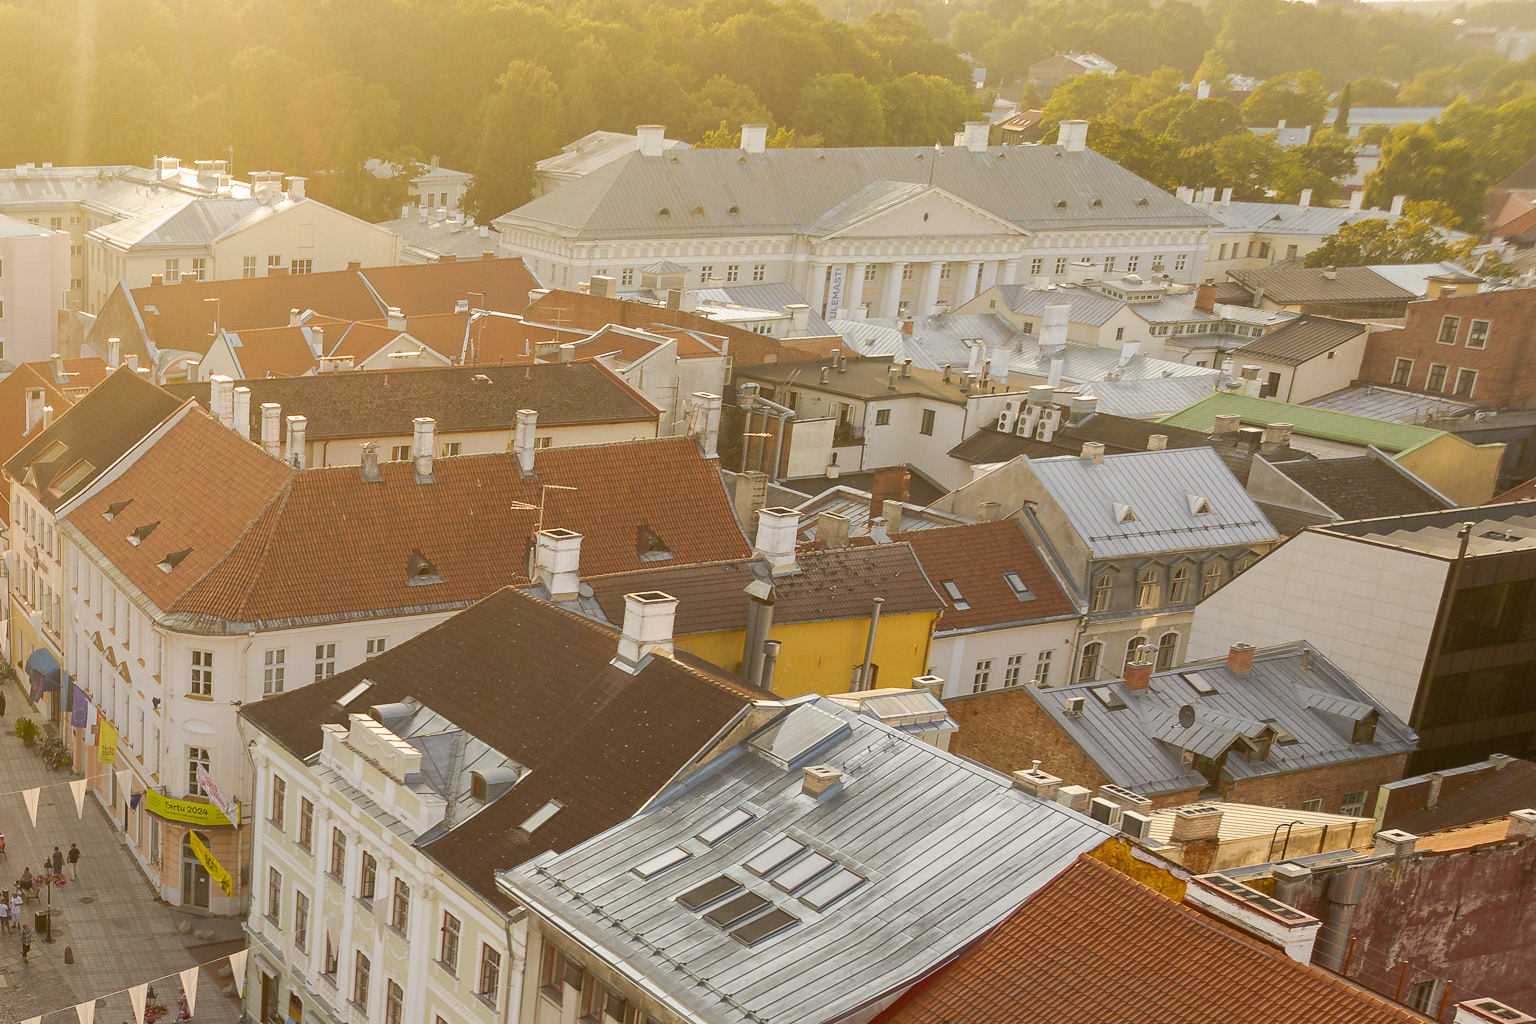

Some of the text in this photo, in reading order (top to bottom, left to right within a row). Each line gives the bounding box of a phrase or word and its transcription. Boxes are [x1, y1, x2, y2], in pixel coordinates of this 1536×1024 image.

[829, 268, 843, 321] ULEMAST!
[164, 801, 185, 812] Tartu
[186, 805, 209, 815] 2024
